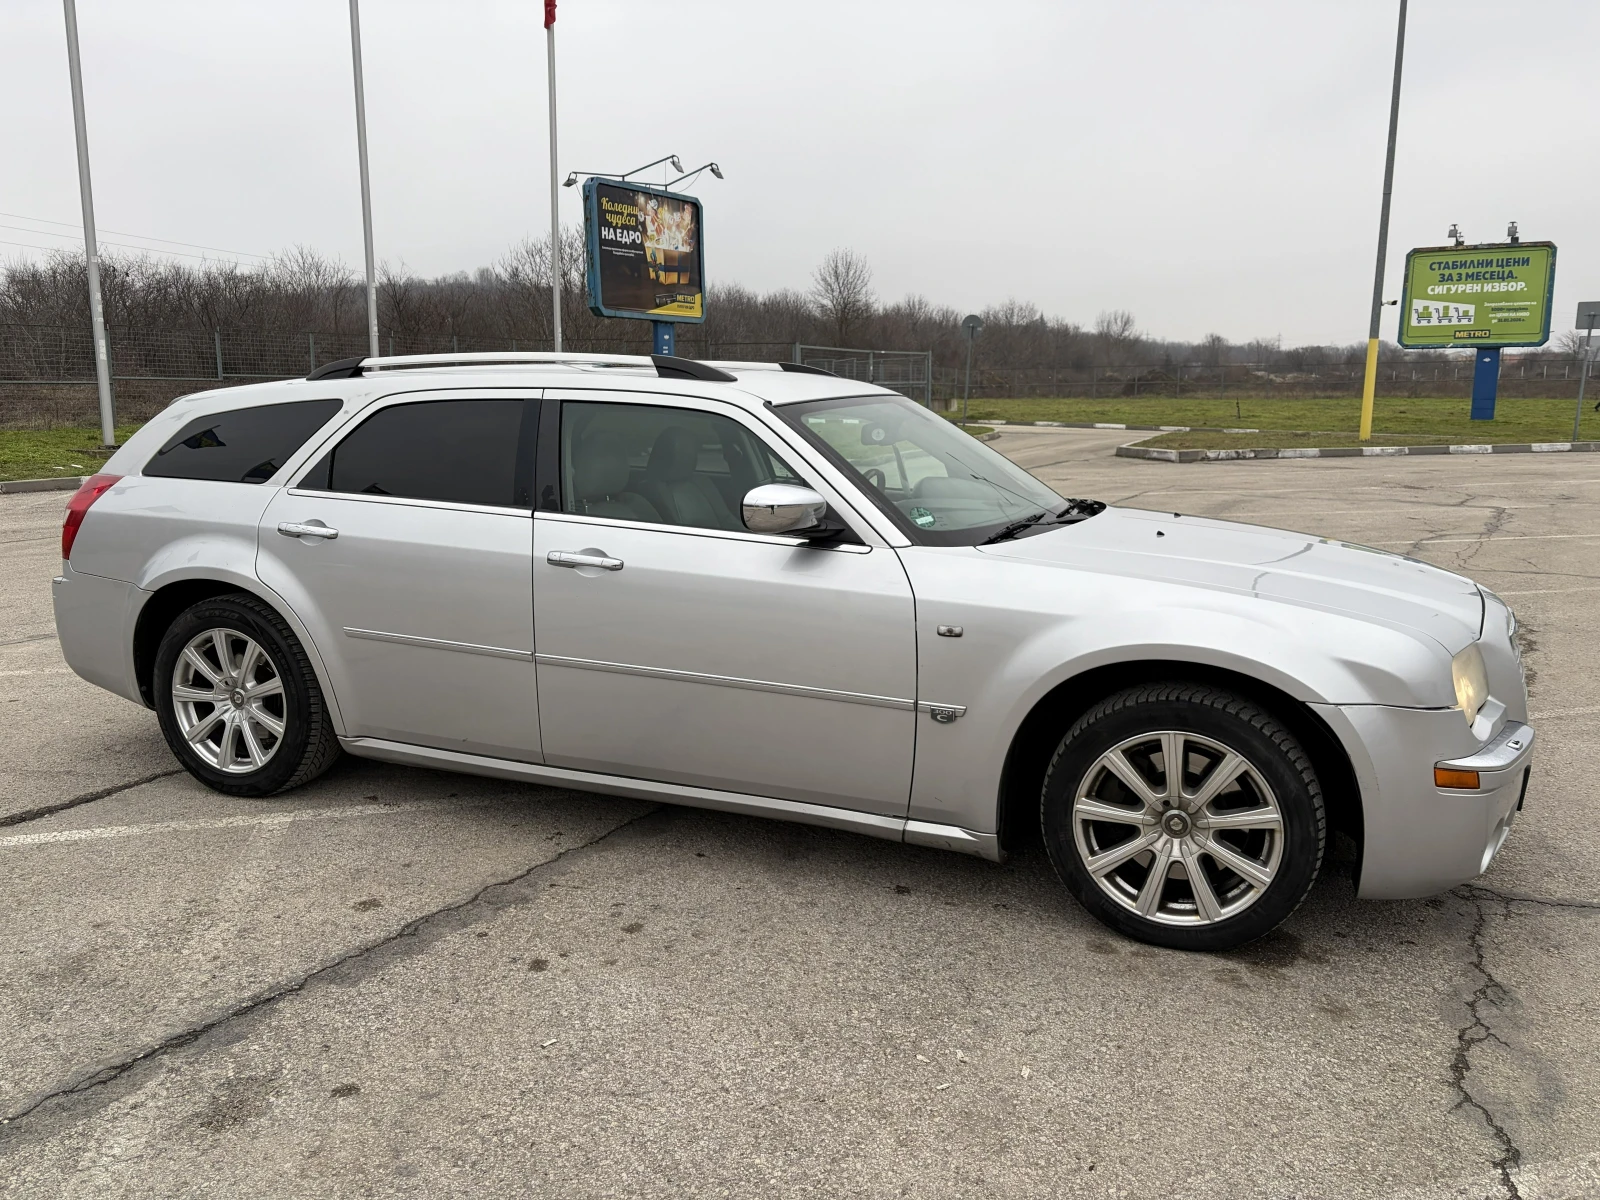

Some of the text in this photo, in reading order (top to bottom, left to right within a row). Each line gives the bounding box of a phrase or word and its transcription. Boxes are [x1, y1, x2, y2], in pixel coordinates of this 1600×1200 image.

[606, 213, 635, 226] чудеса
[602, 226, 641, 245] НА ЕДРО
[1429, 257, 1530, 271] СТАБИЛНИ ЦЕНИ
[1438, 270, 1518, 282] ЗА 3 МЕСЕЦА.
[1427, 281, 1527, 295] СИГУРЕН ИЗБОР.
[676, 294, 695, 303] METRO
[1455, 330, 1490, 338] METRO
